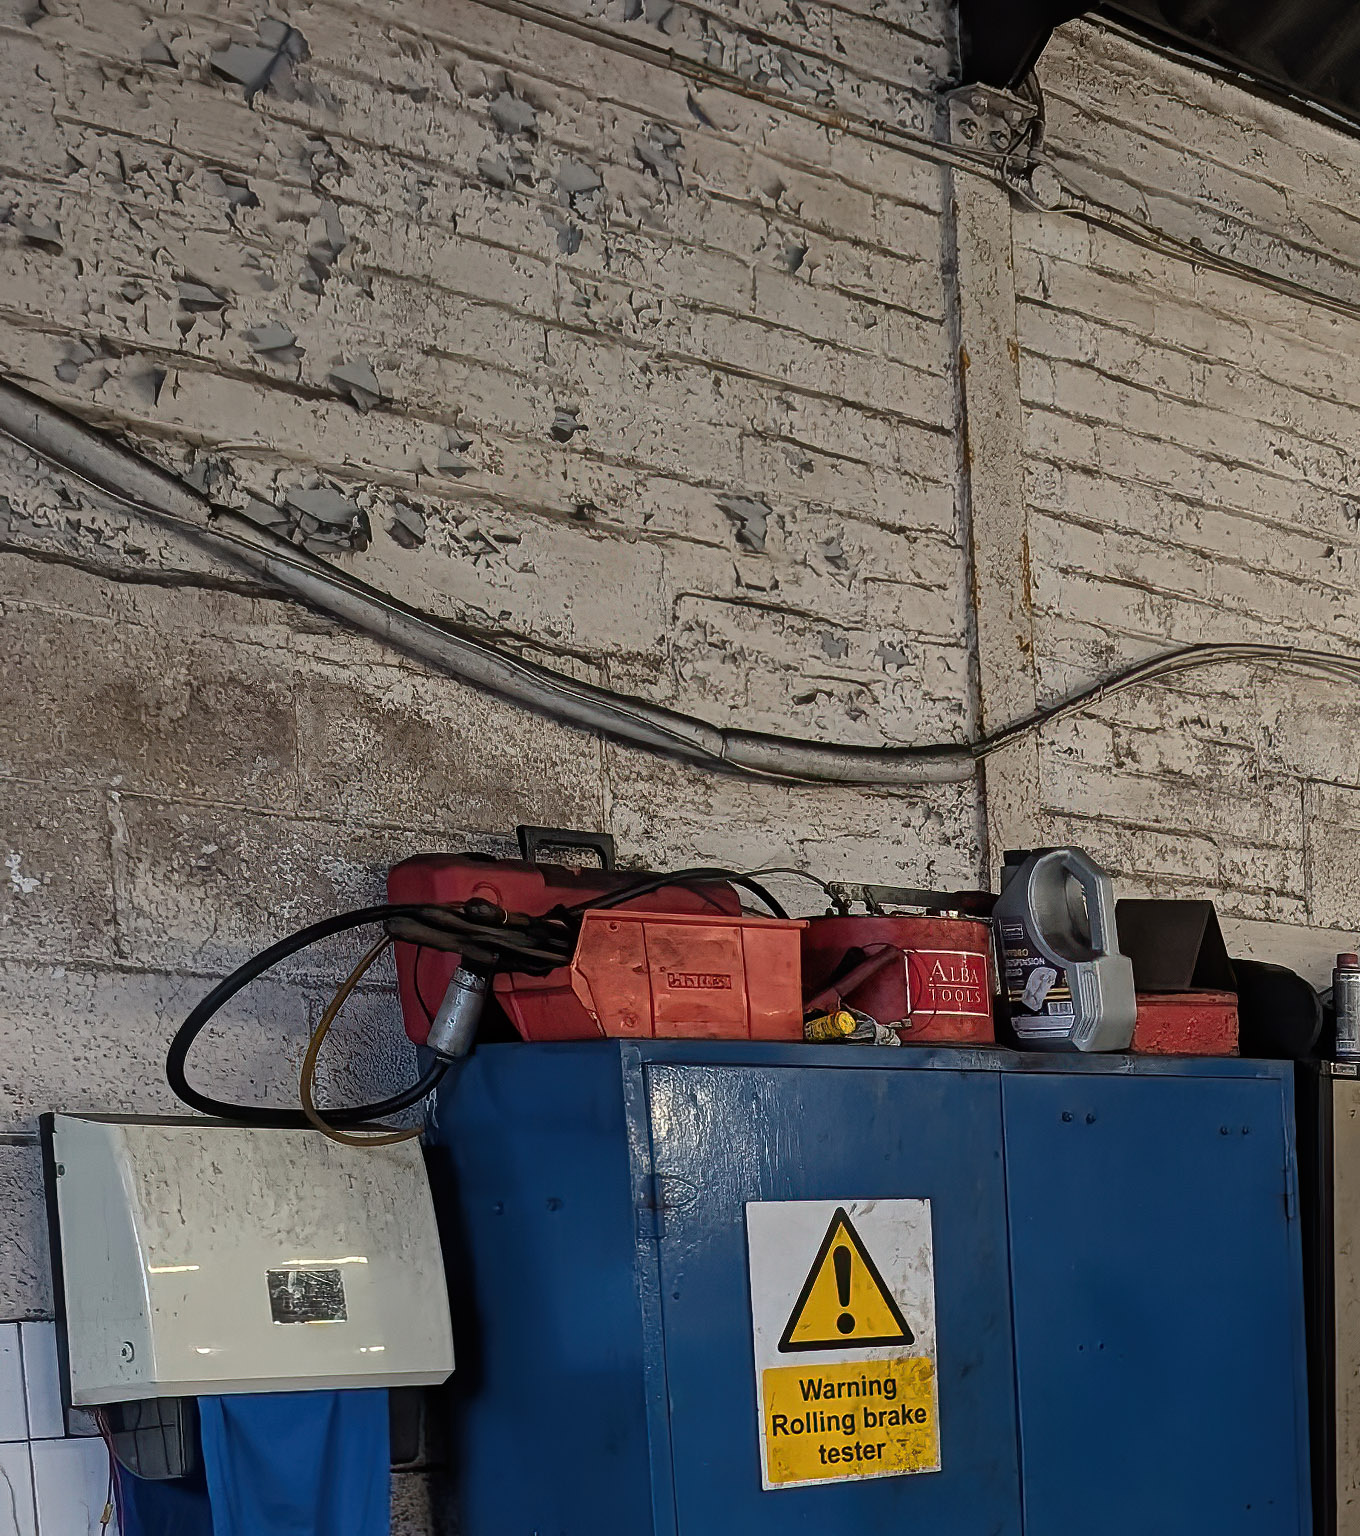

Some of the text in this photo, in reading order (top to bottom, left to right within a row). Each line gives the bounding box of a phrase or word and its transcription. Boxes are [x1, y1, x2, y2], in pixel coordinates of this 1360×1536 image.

[929, 959, 979, 983] ALBA
[928, 988, 980, 1003] TOOLS
[799, 1375, 897, 1401] Warning
[771, 1404, 927, 1437] Rolling brake
[818, 1440, 887, 1464] tester
